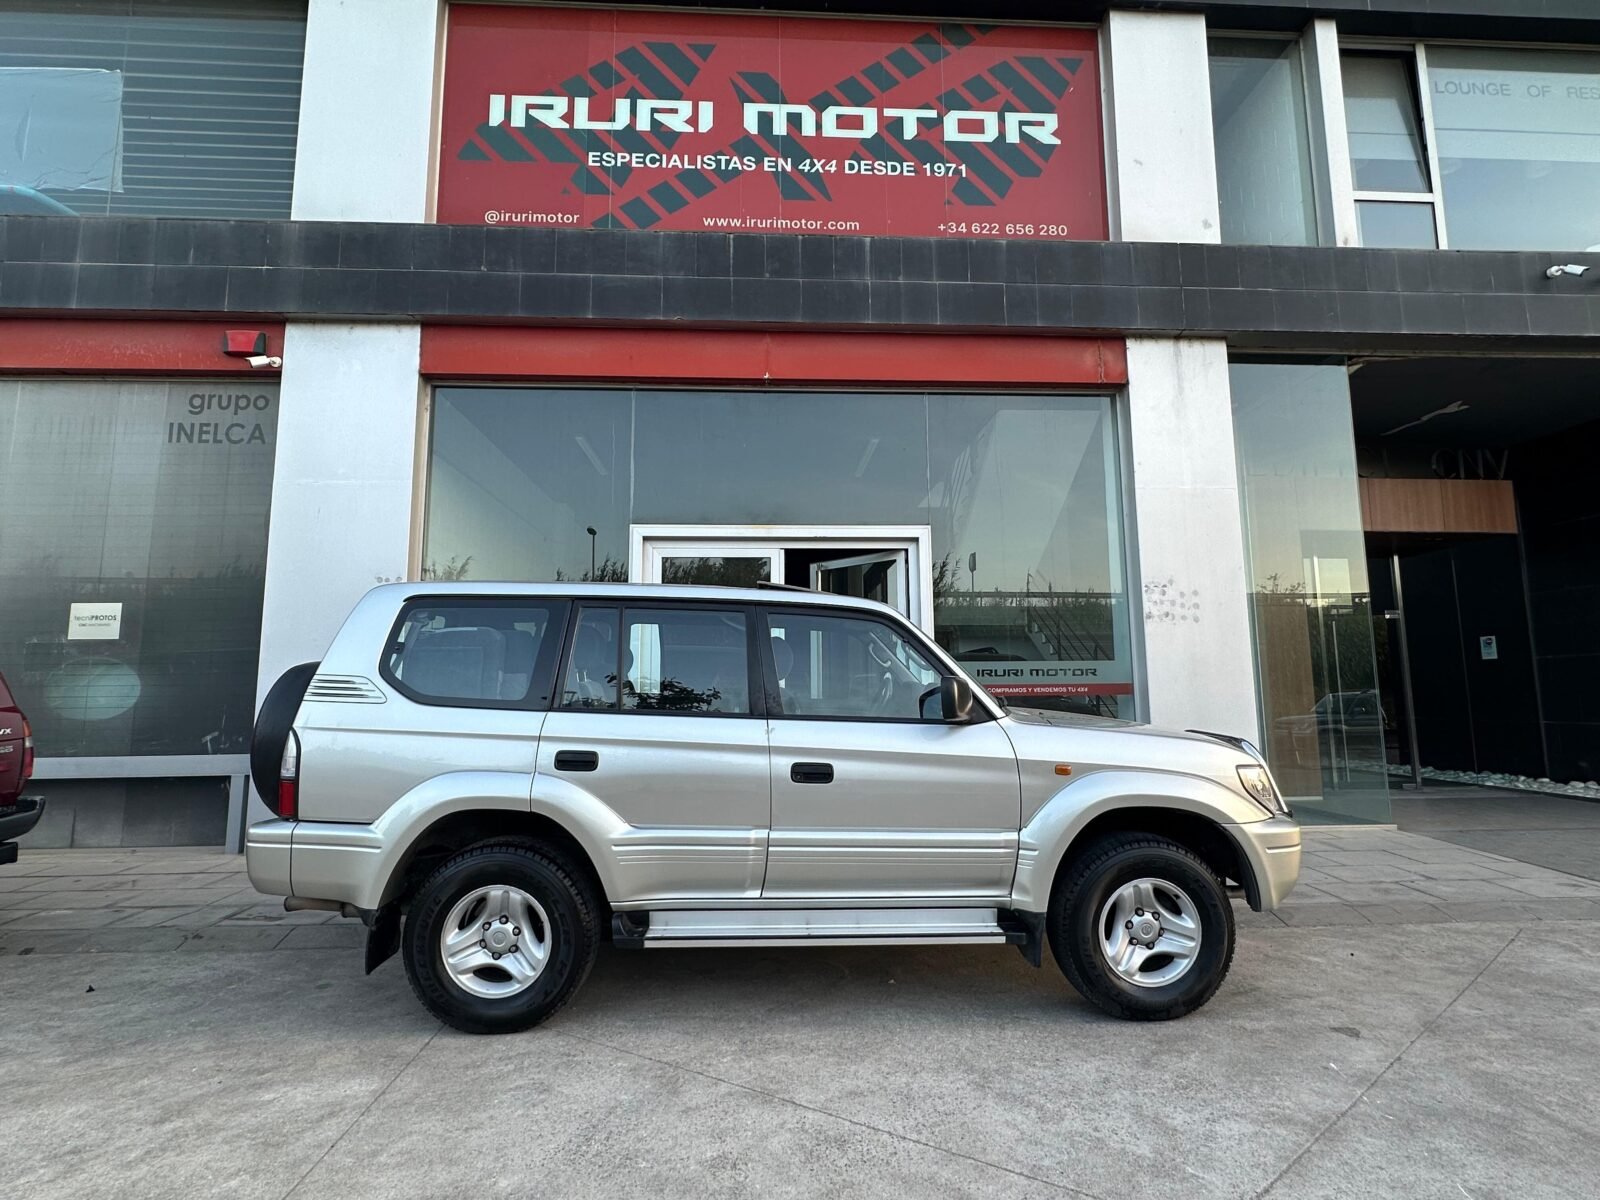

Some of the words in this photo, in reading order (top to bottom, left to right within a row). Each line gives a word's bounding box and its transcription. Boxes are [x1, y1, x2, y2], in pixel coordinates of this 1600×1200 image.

[1434, 80, 1512, 97] LOUNGE
[1526, 85, 1552, 98] OF
[488, 94, 714, 133] IRURI
[743, 102, 1062, 145] MOTOR
[587, 151, 757, 171] ESPECIALISTAS
[763, 157, 792, 172] EN
[798, 158, 838, 174] 4X4
[844, 159, 915, 177] DESDE
[922, 162, 967, 178] 1971
[484, 210, 580, 224] @irurimotor
[702, 216, 860, 231] www.irurimotor.com
[937, 222, 967, 234] +34
[971, 223, 1000, 235] 622
[1005, 224, 1034, 236] 656
[1039, 224, 1068, 236] 280
[188, 393, 270, 416] grupo
[167, 422, 266, 445] INELCA
[976, 669, 1023, 677] IRURI
[1029, 668, 1098, 677] MOTOR
